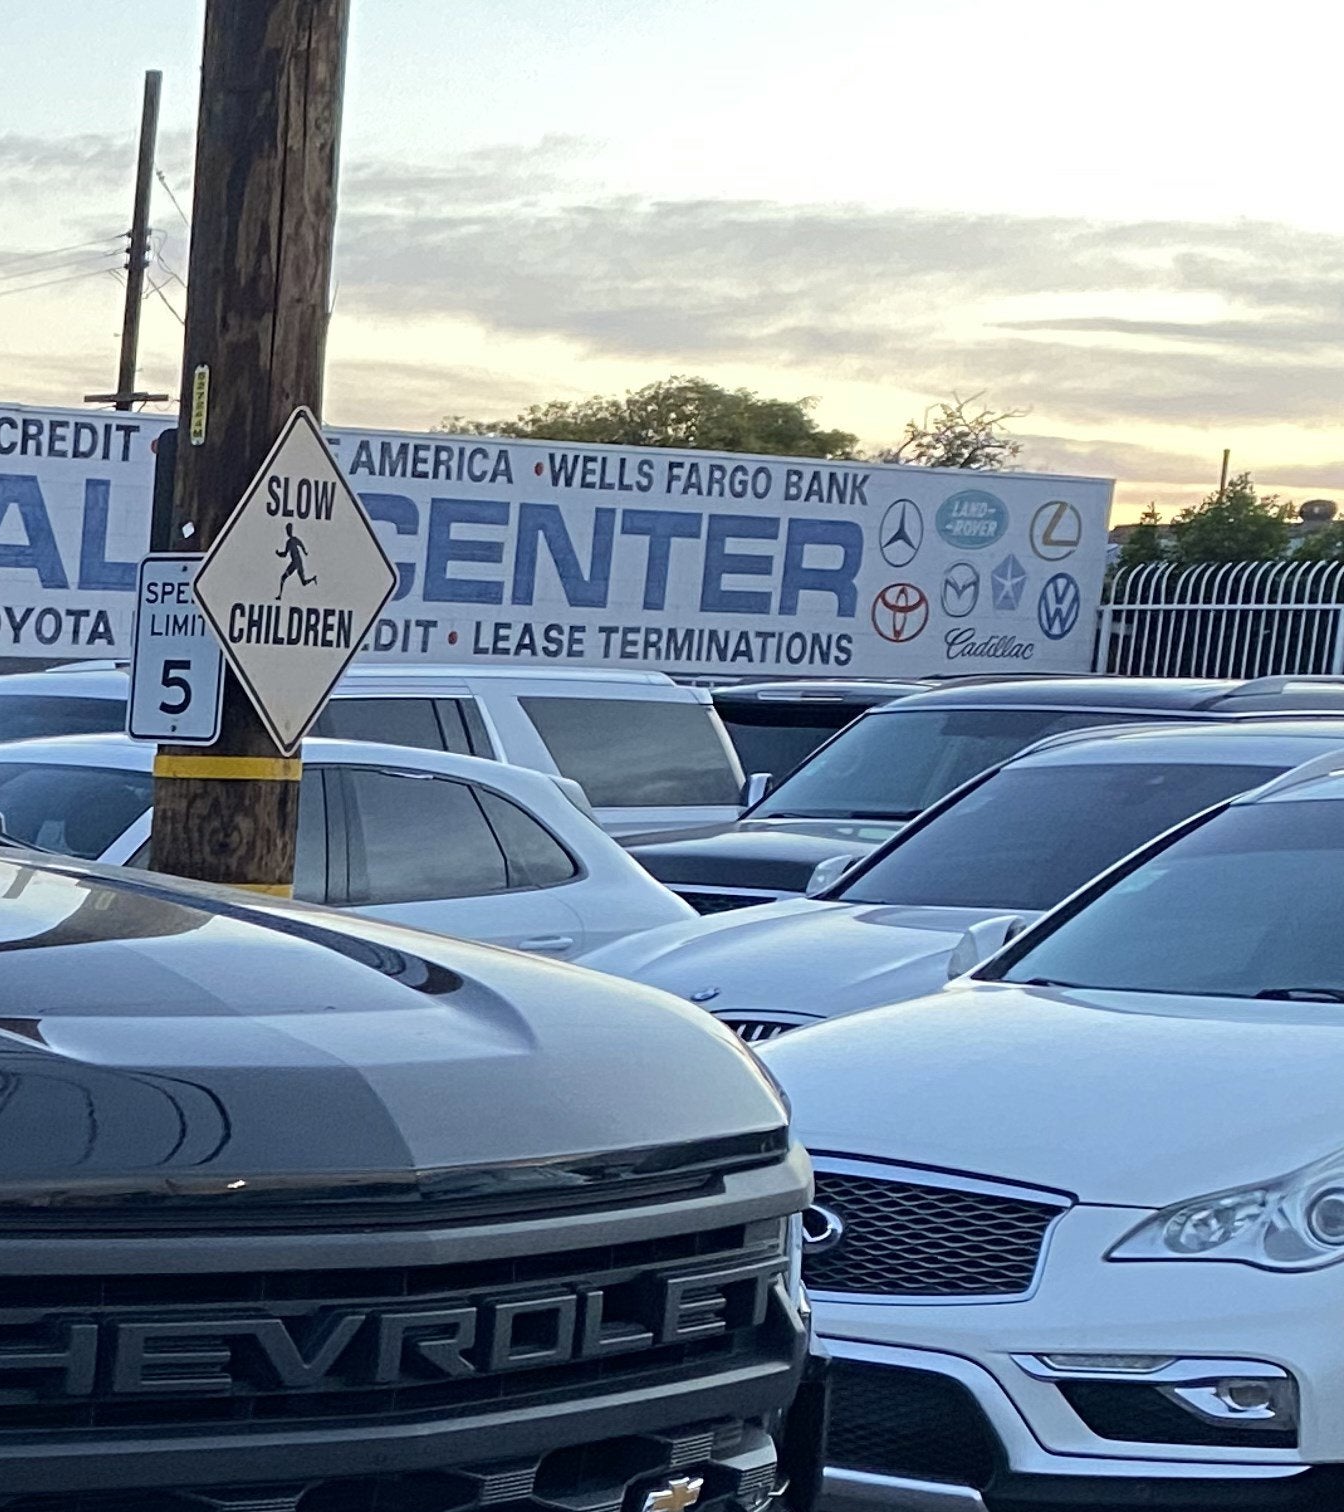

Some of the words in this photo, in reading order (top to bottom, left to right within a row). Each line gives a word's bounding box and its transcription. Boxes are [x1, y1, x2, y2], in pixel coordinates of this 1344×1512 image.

[349, 440, 513, 484] AMERICA
[549, 453, 653, 496] WELLS
[666, 461, 772, 501] FARGO
[784, 467, 870, 506] BANK
[266, 475, 337, 521] SLOW
[145, 582, 195, 604] SPE
[150, 614, 206, 636] LIMIT
[228, 603, 353, 649] CHILDREN
[473, 620, 585, 660] LEASE
[599, 628, 853, 667] TERMINATIONS
[945, 627, 1035, 660] Cadillac
[159, 660, 192, 715] 5
